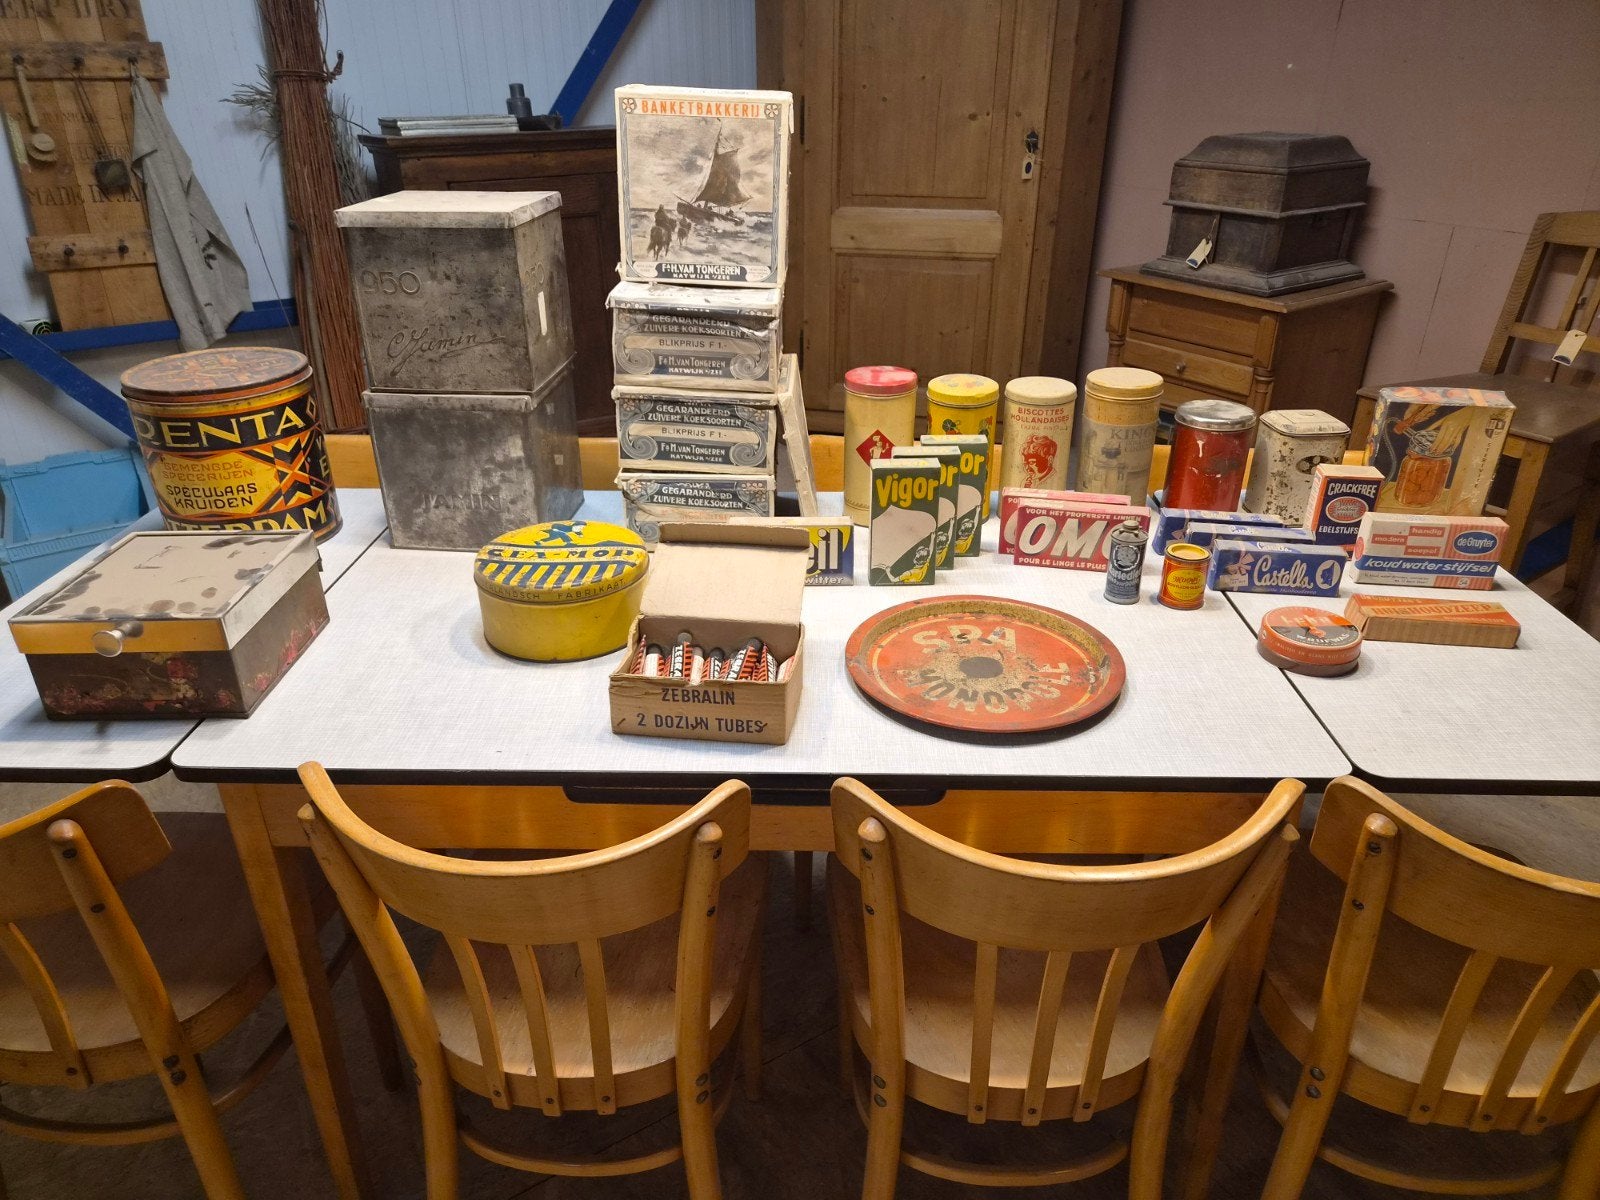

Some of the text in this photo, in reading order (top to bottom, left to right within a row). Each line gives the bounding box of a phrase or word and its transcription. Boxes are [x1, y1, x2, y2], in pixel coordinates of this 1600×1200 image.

[642, 99, 760, 117] BANKETBAKKERIJ
[696, 264, 740, 275] TONGEREN
[361, 270, 421, 295] 950
[644, 323, 679, 333] ZUIVERE
[659, 339, 705, 348] BLIKPRIJS
[690, 355, 726, 368] TONGEREN
[656, 404, 731, 416] GEGARANDEERD
[1018, 407, 1064, 416] BISCOTTES
[647, 412, 741, 427] ZUIVERE KOEKSOORTEN
[1011, 413, 1070, 424] HOLLANDAISES
[134, 405, 307, 448] PENTA
[670, 453, 705, 461] KATWIJK
[690, 444, 726, 456] TONGEREN
[163, 460, 244, 472] GEMENGDE
[162, 468, 253, 482] SPECERIJEN
[166, 482, 258, 499] SPECULAAS
[876, 473, 940, 508] Vigor
[1328, 481, 1377, 499] CRACKFREE
[174, 495, 254, 510] KRUIDEN
[422, 493, 502, 513] JAMIN
[653, 494, 743, 509] ZUIVERE KOEKSOORTEN
[1026, 507, 1047, 515] VOOR
[1066, 510, 1111, 520] PROPERSTE
[1412, 527, 1443, 536] handig
[1407, 547, 1437, 555] soepel
[1018, 557, 1040, 565] POUR
[1042, 558, 1050, 566] LE
[1052, 560, 1075, 568] LINGE
[1087, 562, 1107, 570] PLUS
[1365, 558, 1495, 574] koud water stijfsel
[1253, 554, 1314, 589] Castella
[912, 624, 1017, 655] SPA
[896, 661, 1072, 714] MONOPOLE
[661, 688, 735, 705] ZEBRALIN
[637, 712, 764, 733] 2 DOZIJN TUBES
